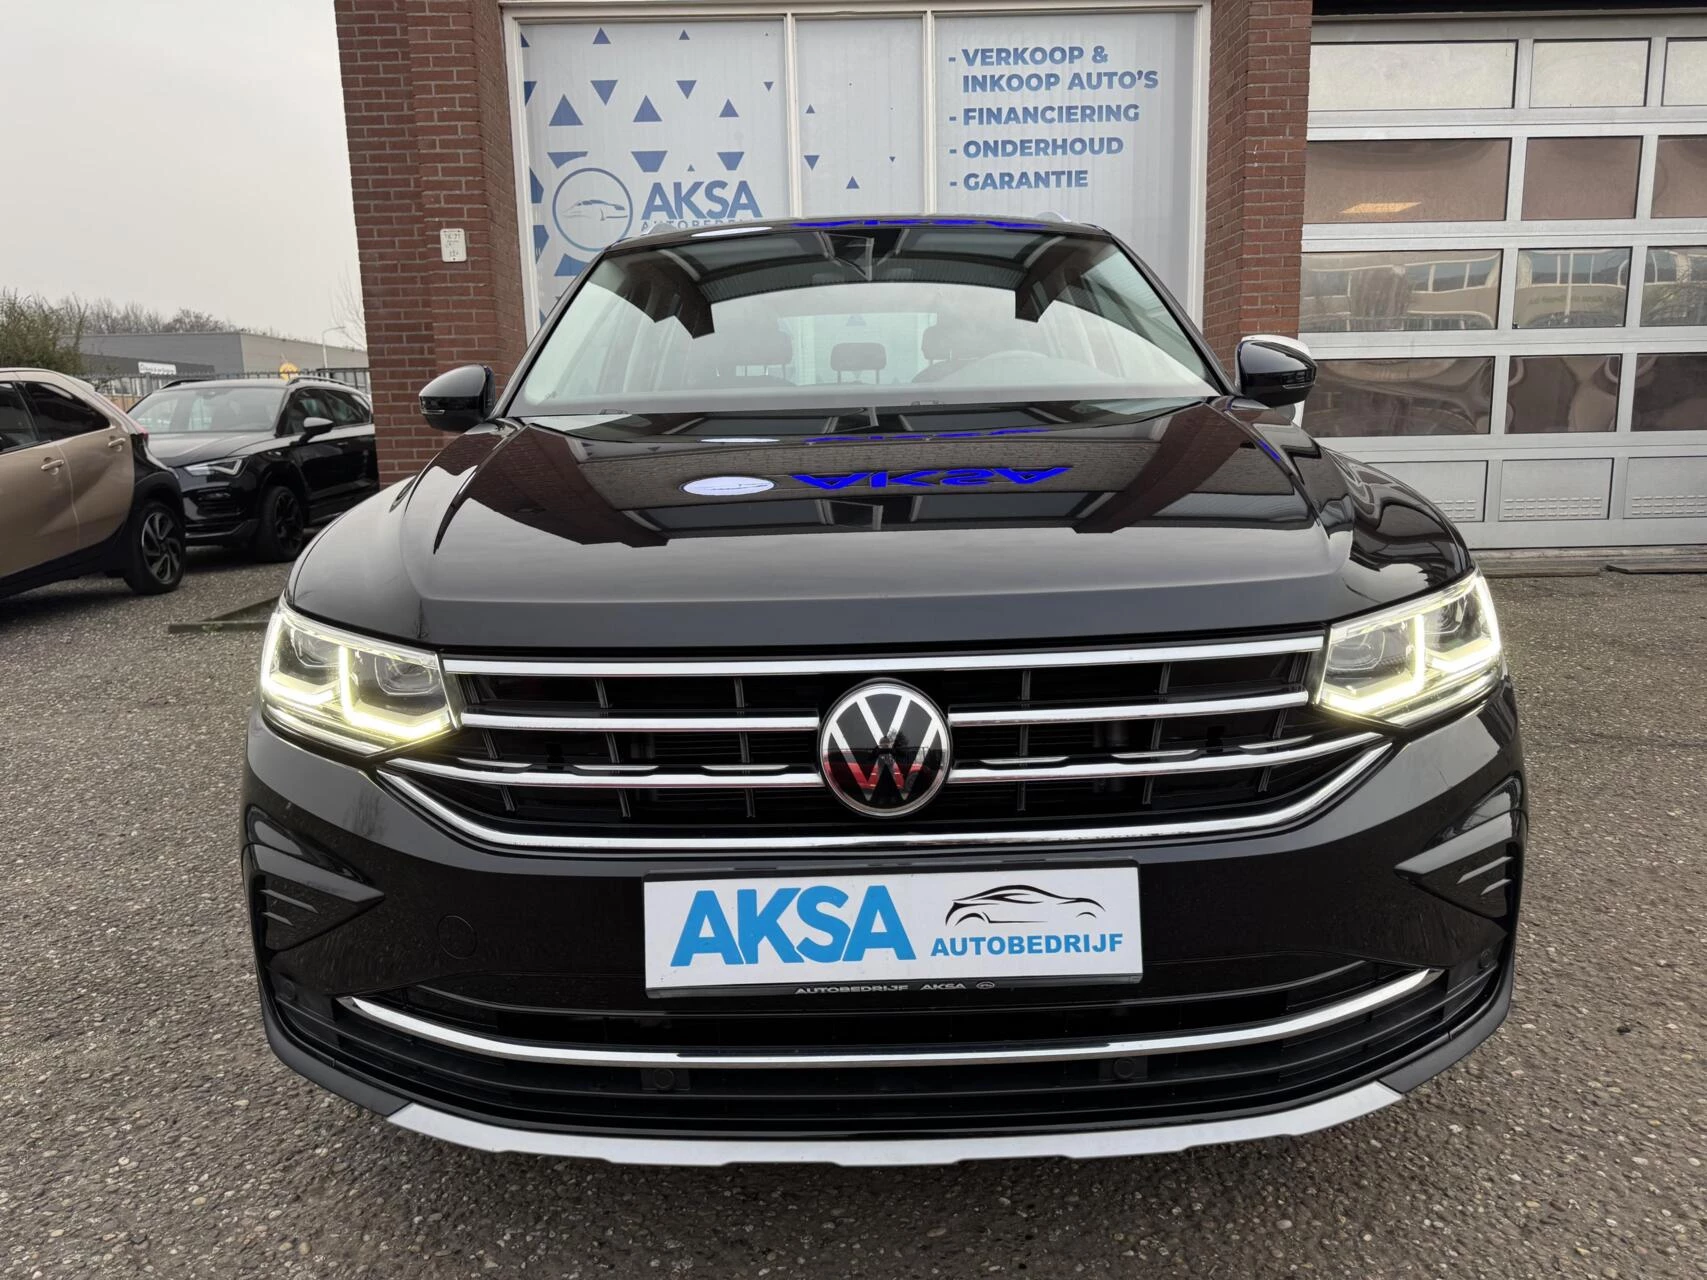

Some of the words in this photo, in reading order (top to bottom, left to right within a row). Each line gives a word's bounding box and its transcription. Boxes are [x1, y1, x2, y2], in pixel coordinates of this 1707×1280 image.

[961, 46, 1084, 67] VERKOOP
[1091, 45, 1109, 65] &
[962, 73, 1061, 93] INKOOP
[1067, 70, 1159, 91] AUTO'S
[963, 103, 1140, 126] FINANCIERING
[963, 136, 1124, 159] ONDERHOUD
[963, 169, 1089, 191] GARANTIE
[641, 180, 764, 220] AKSA
[670, 884, 917, 967] AKSA
[930, 933, 1124, 957] AUTOBEDRIJF
[795, 984, 909, 995] AUTOBEDRIJF
[920, 982, 967, 991] AKSA
